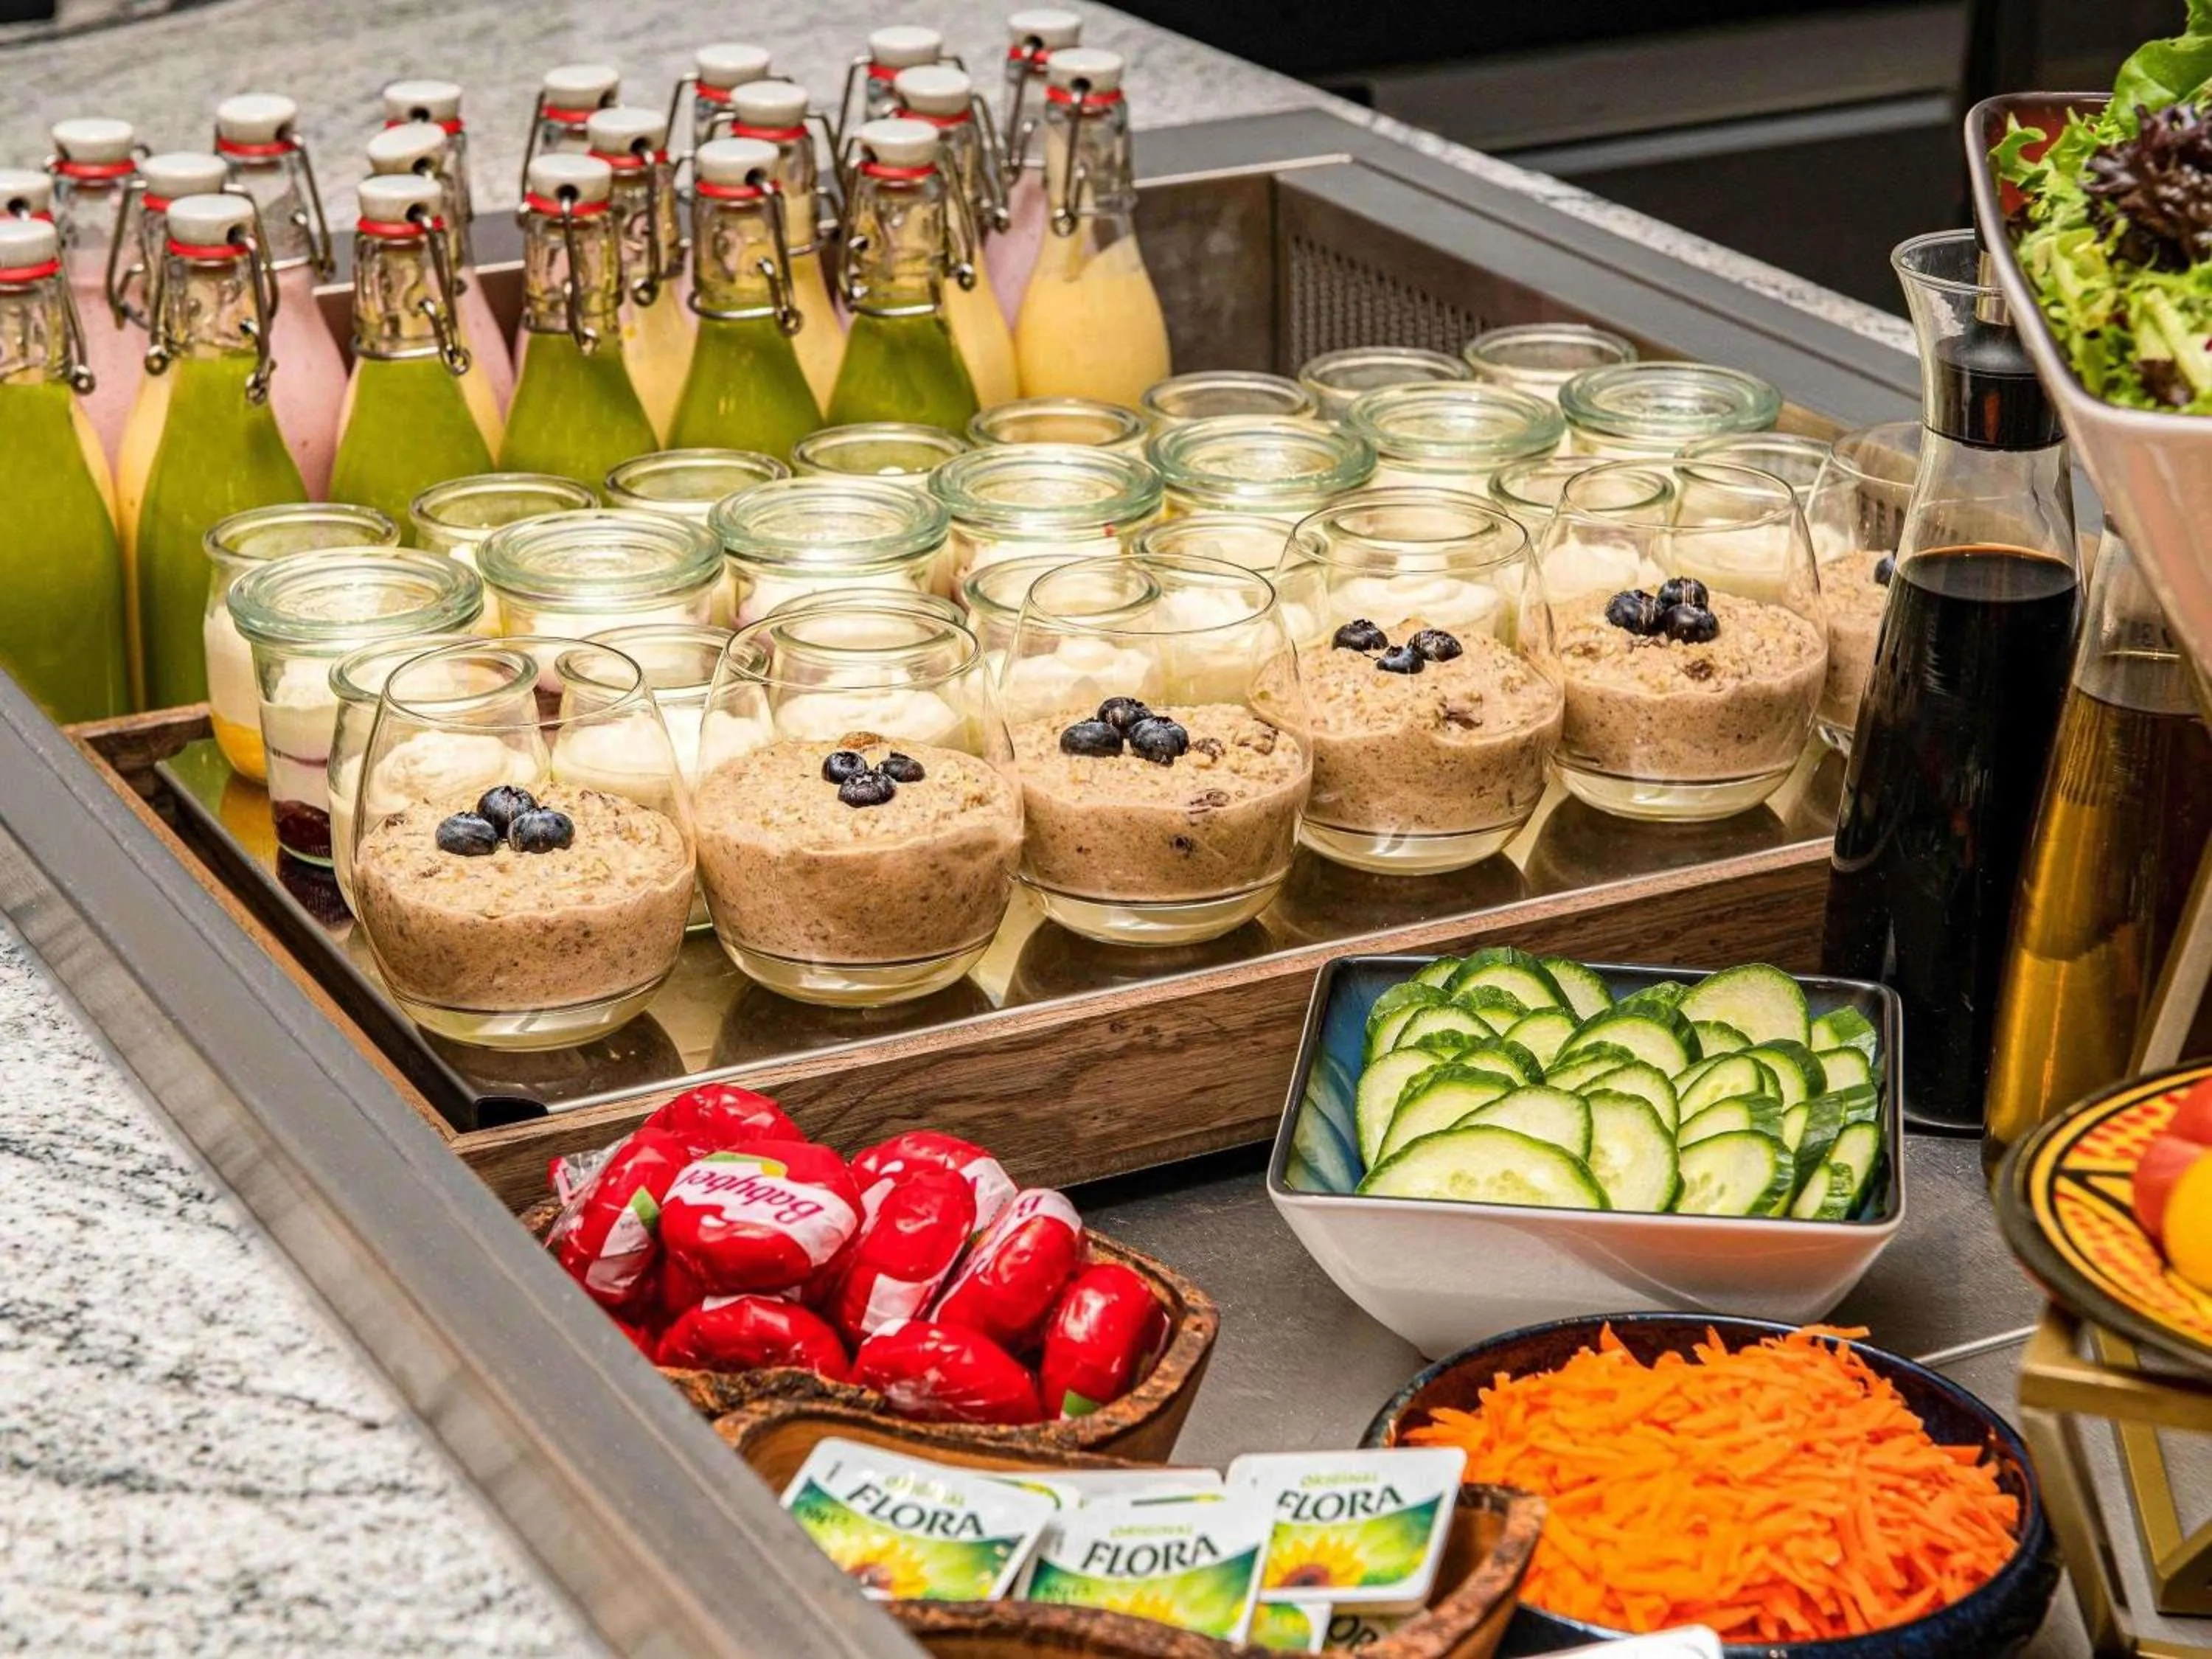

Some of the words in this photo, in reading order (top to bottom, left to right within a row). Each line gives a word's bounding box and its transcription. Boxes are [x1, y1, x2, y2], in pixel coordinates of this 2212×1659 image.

[675, 1169, 824, 1225] Babybel
[847, 1483, 984, 1537] FLORA
[1276, 1484, 1405, 1522] FLORA
[1080, 1534, 1220, 1577] FLORA
